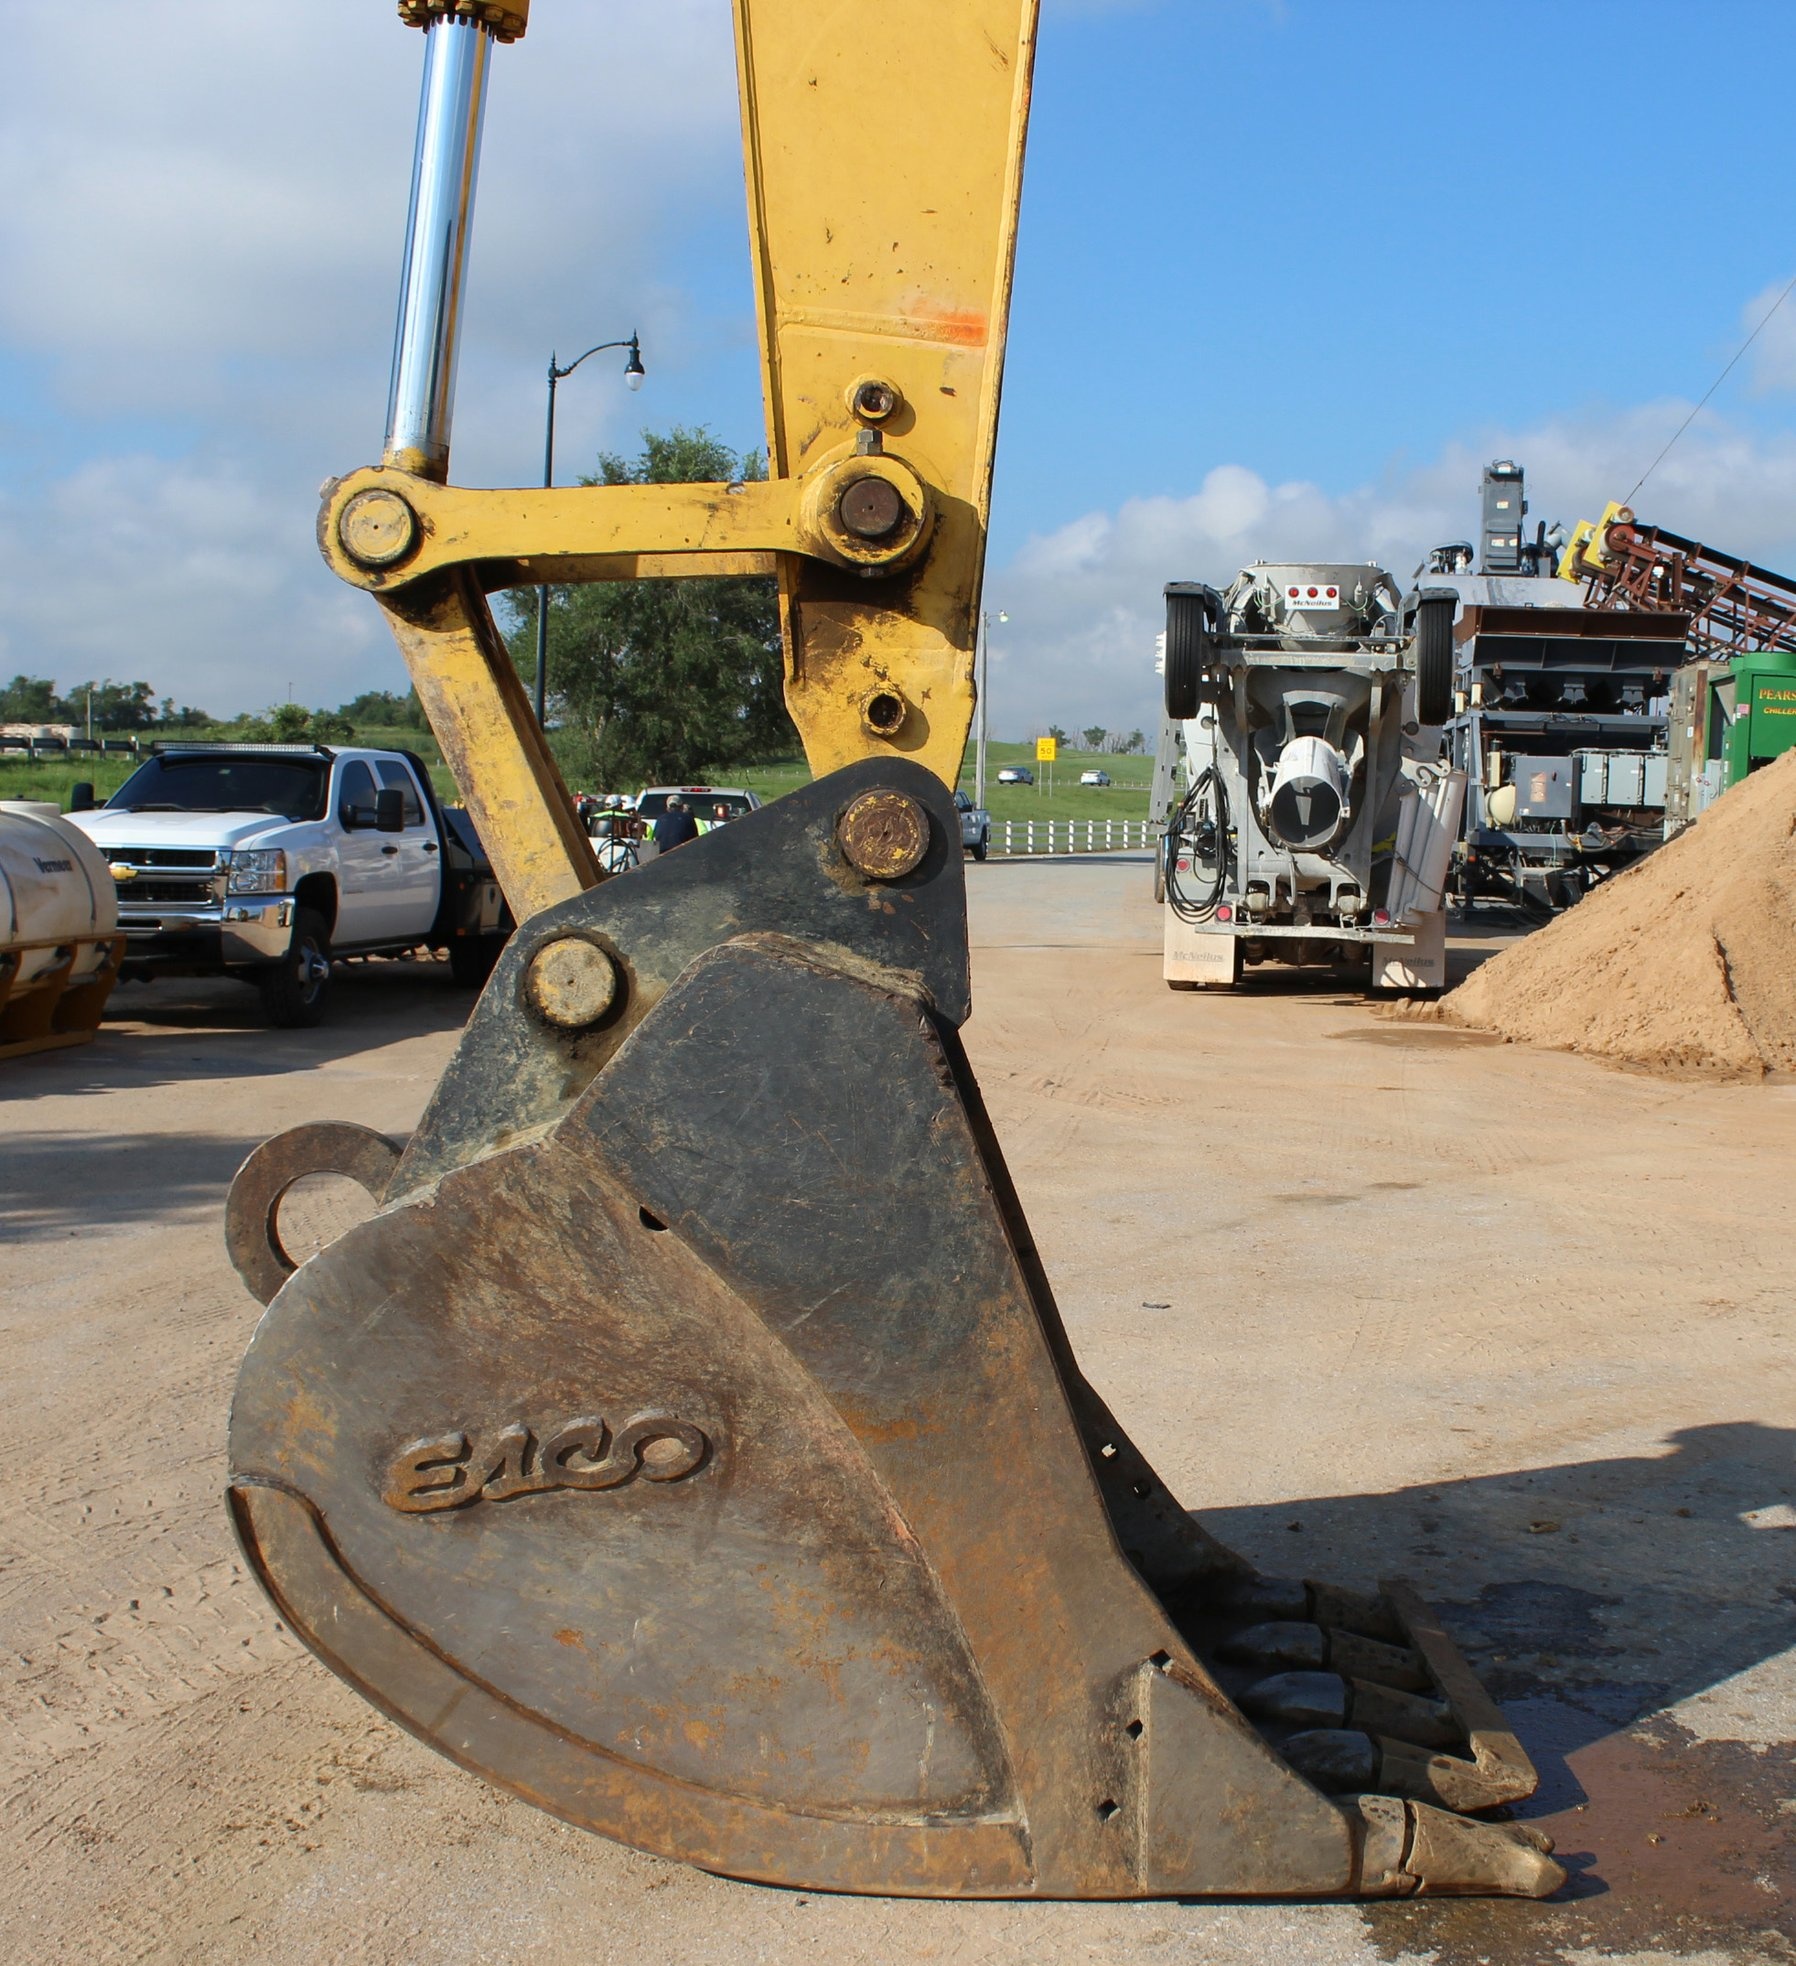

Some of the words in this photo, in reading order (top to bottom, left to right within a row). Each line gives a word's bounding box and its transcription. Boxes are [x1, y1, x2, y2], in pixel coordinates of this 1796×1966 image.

[1040, 747, 1052, 755] 50
[32, 856, 74, 874] Vermeer
[1171, 950, 1224, 962] McNeilus
[382, 1408, 715, 1514] ESCO
